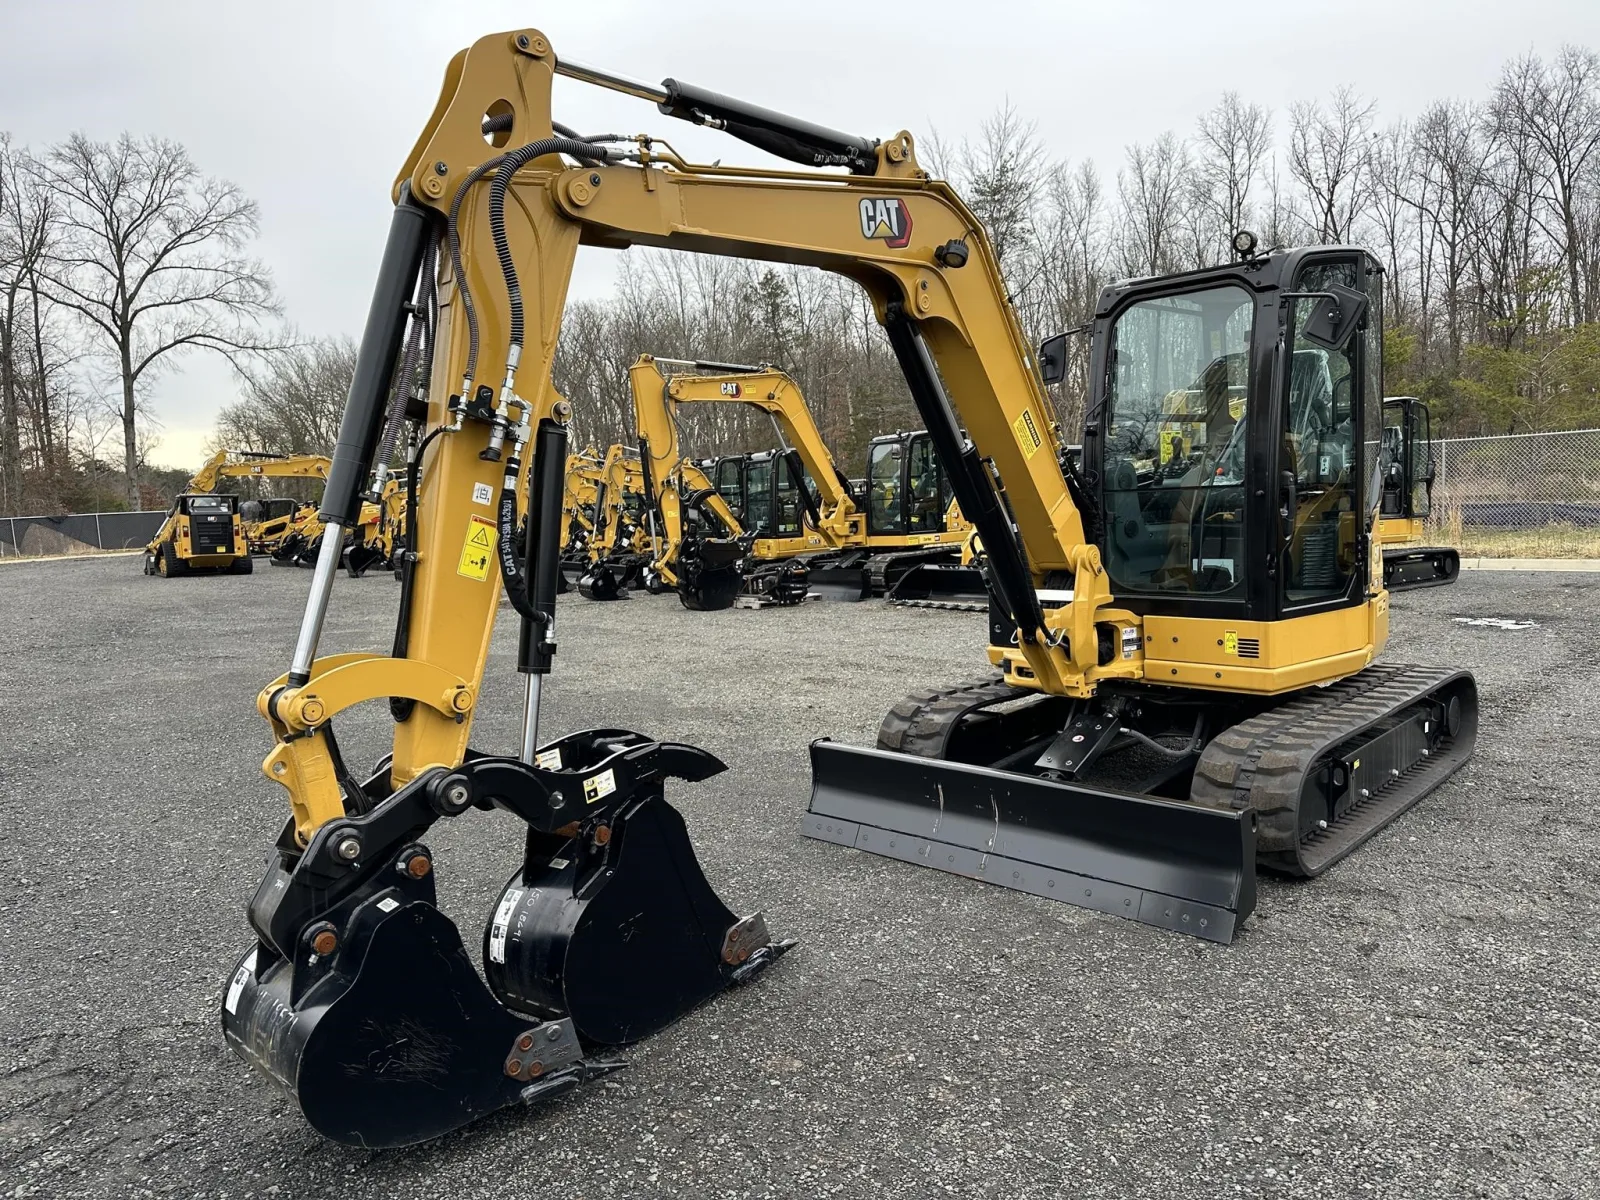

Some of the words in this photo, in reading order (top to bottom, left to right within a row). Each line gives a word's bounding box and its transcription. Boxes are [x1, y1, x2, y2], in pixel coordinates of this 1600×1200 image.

[860, 199, 899, 238] CAT
[721, 382, 737, 395] CAT
[1024, 412, 1040, 446] WARNING
[503, 554, 516, 576] CAT
